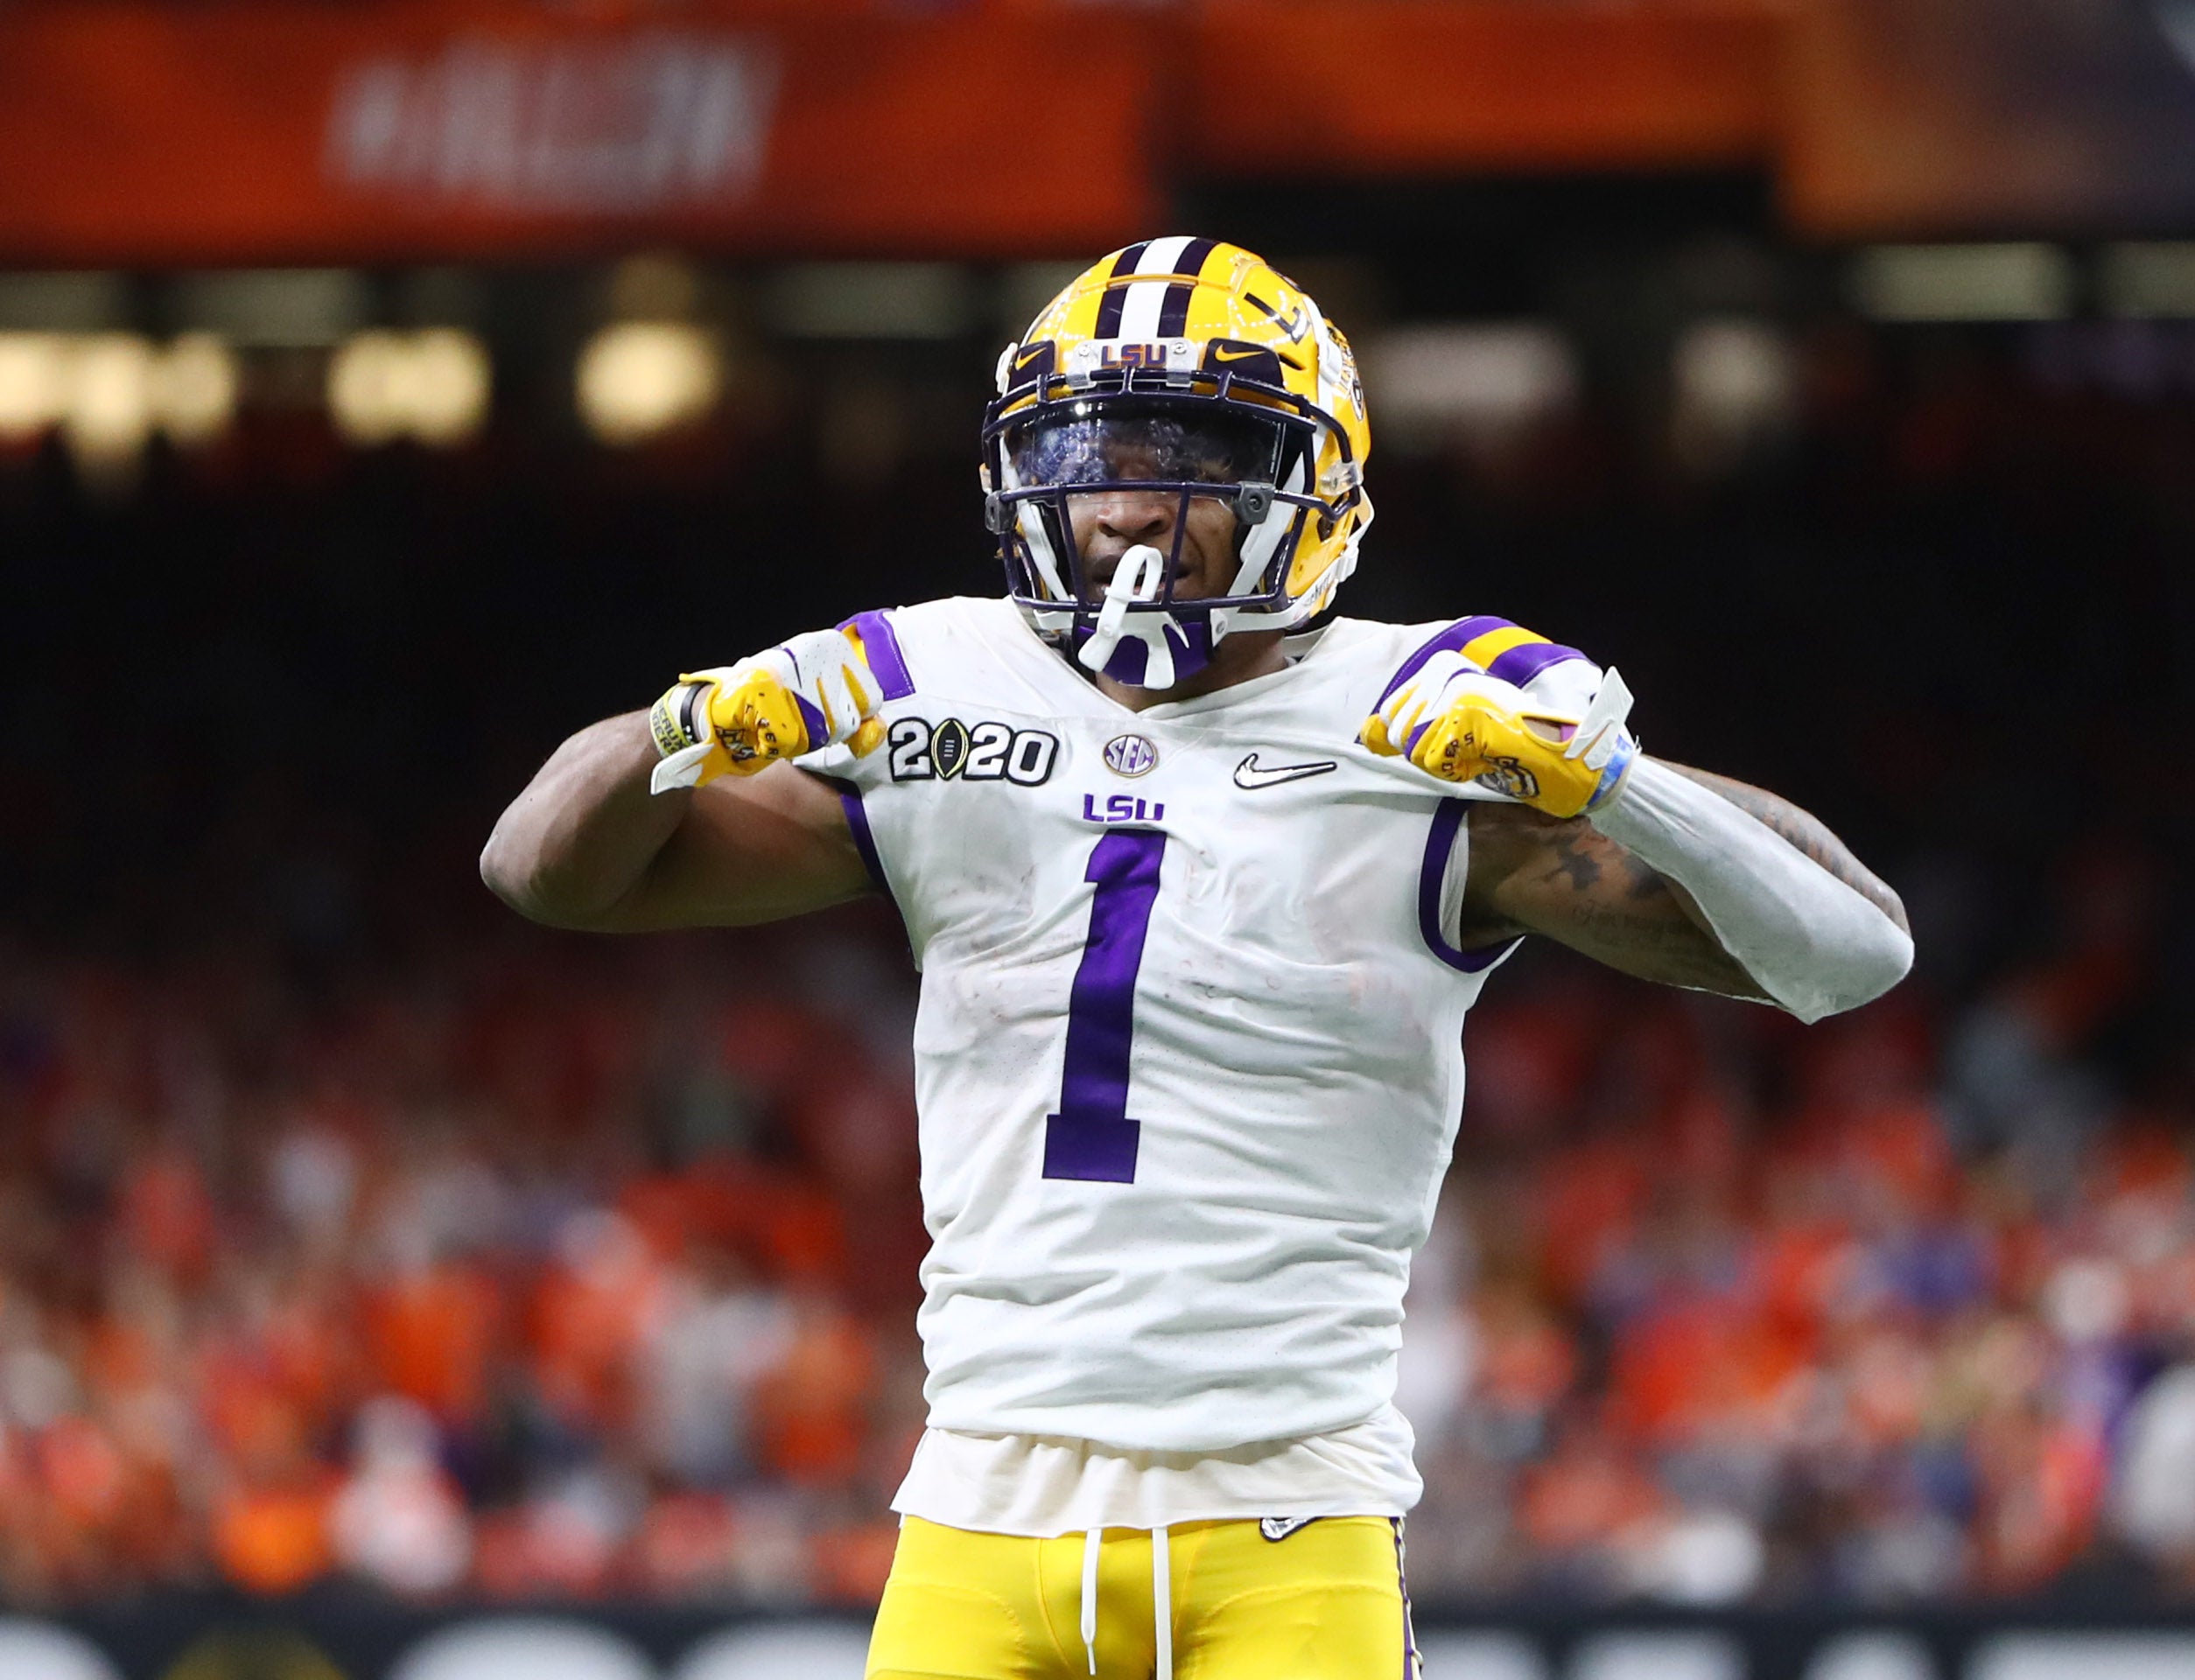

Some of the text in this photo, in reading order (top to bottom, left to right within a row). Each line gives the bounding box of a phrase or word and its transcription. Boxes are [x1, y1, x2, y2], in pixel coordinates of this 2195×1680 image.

[1101, 344, 1167, 368] LSU
[1104, 735, 1157, 776] SEC
[1083, 793, 1165, 822] LSU
[1041, 828, 1168, 1185] 1
